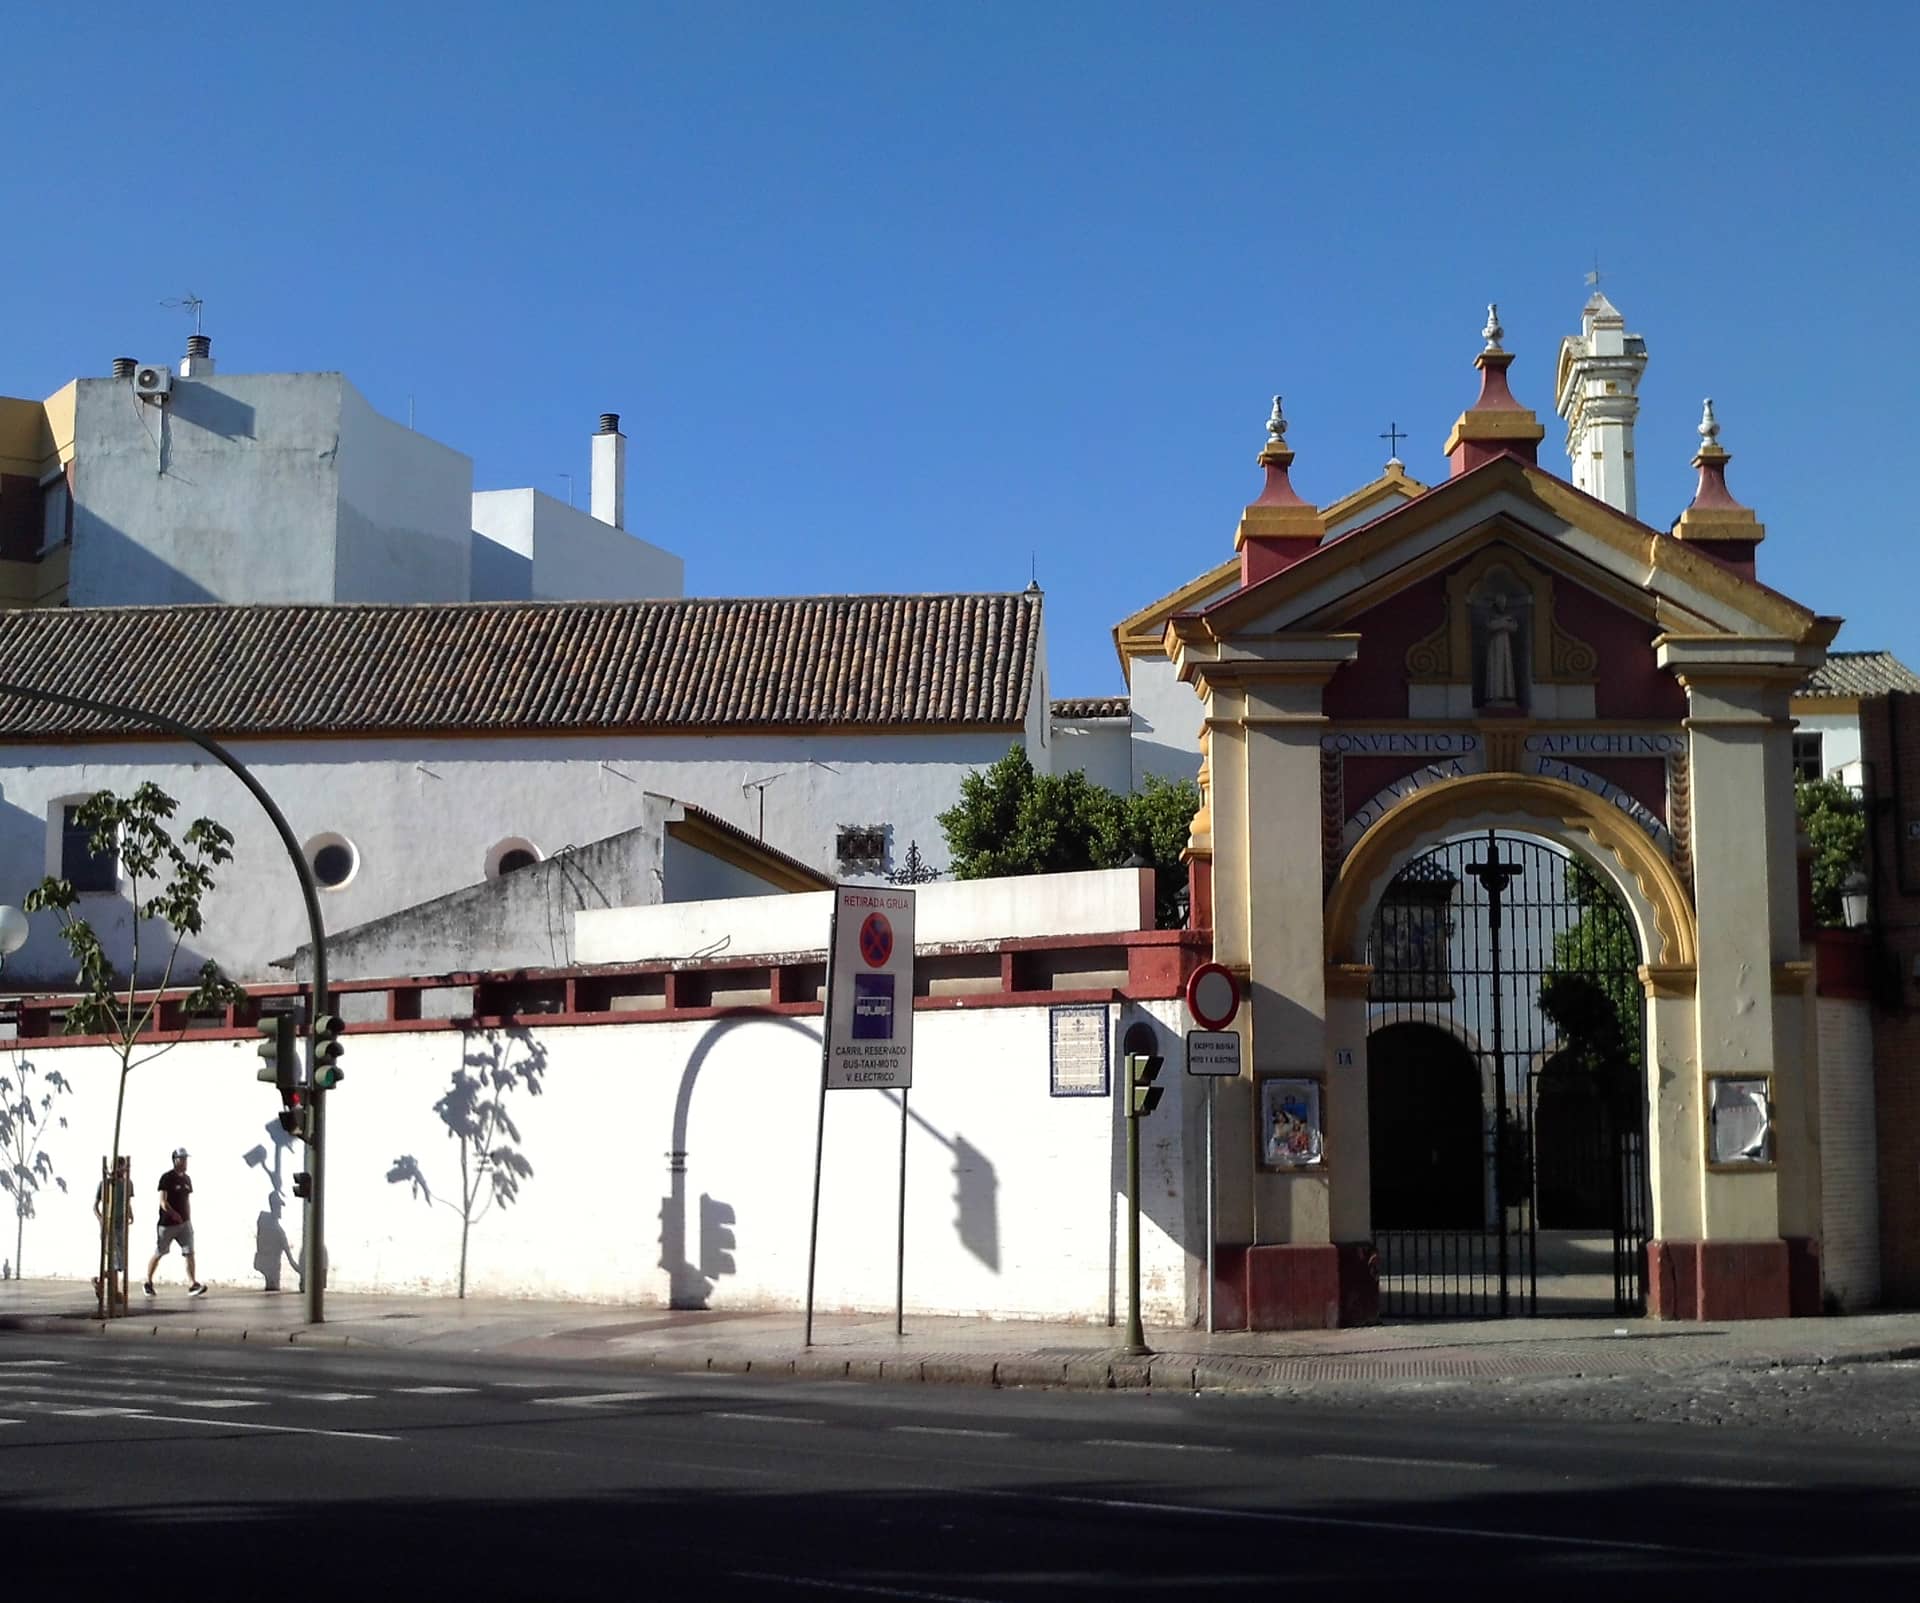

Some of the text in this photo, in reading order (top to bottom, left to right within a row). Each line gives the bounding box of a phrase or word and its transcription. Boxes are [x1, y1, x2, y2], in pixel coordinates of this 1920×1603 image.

[1320, 735, 1452, 752] CONVENTO
[1524, 735, 1685, 752] CAPUCHINOS
[1352, 756, 1663, 839] DIVINA PASTORA
[844, 895, 885, 908] RETIRADA
[835, 1046, 907, 1056] CARRIL RESERVADO
